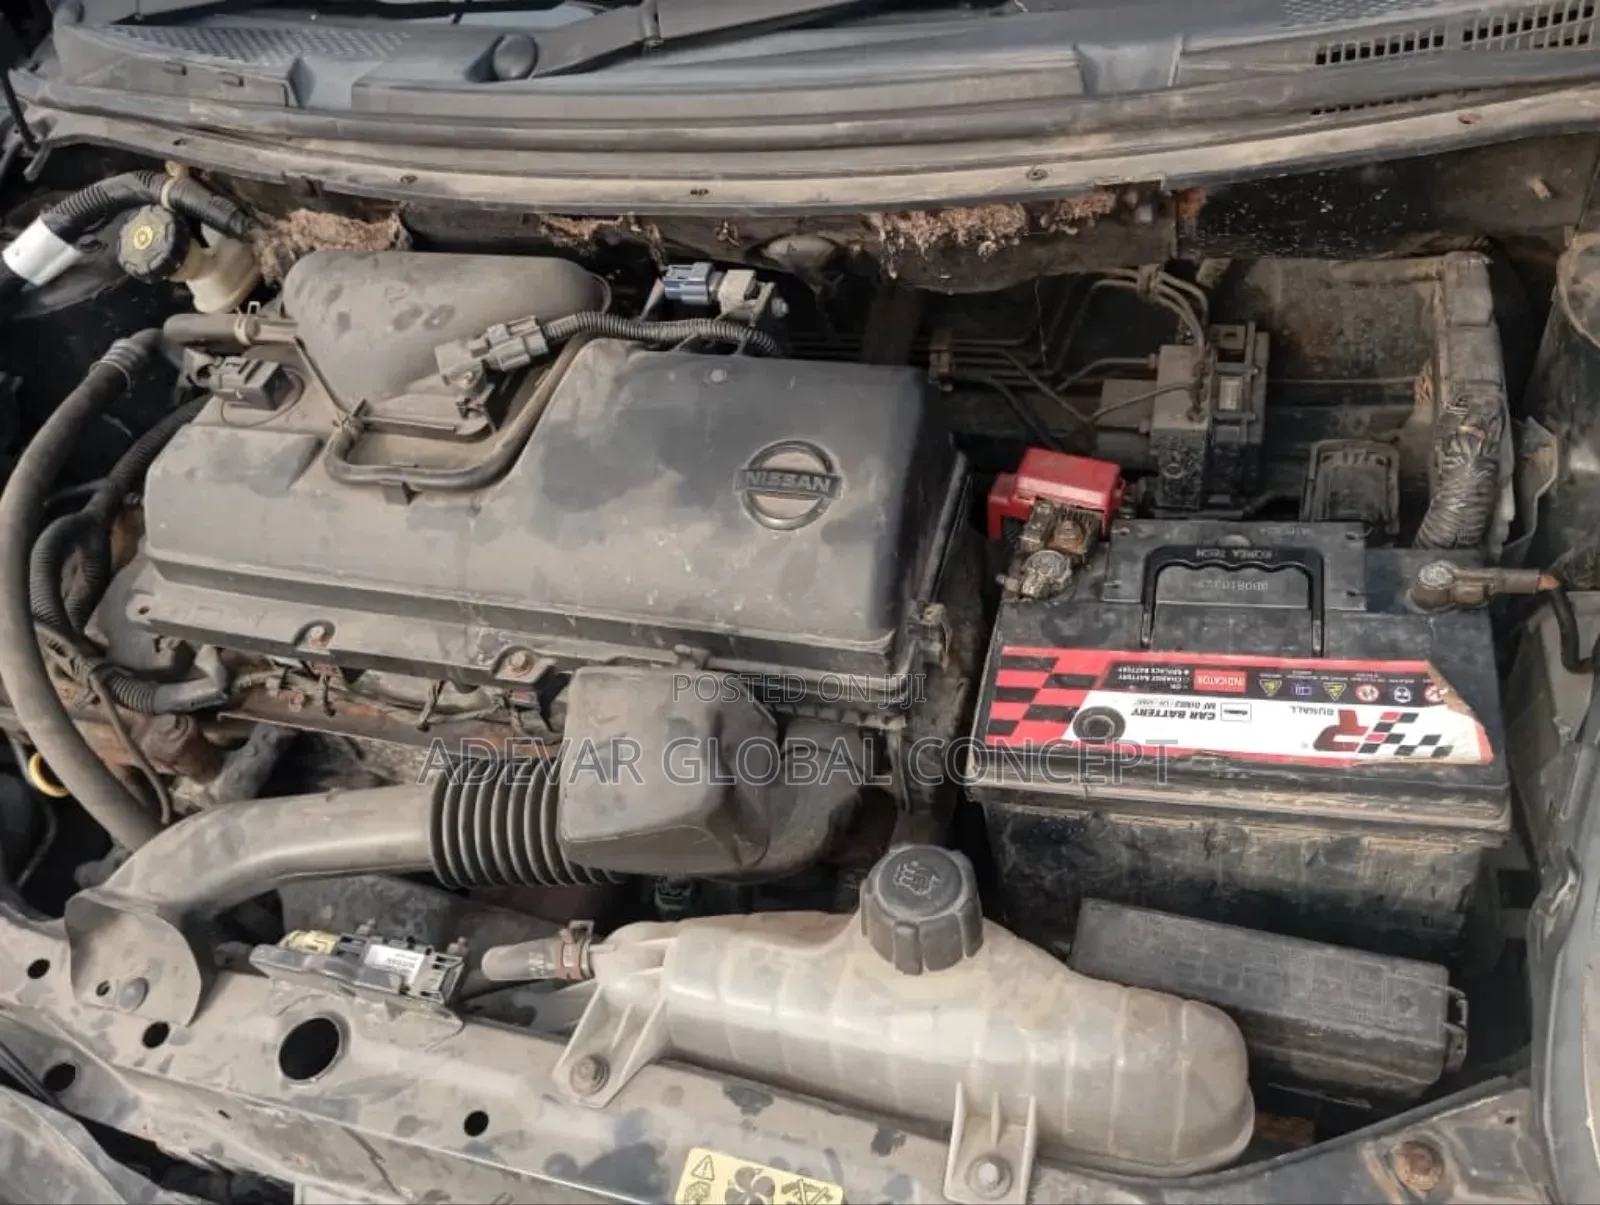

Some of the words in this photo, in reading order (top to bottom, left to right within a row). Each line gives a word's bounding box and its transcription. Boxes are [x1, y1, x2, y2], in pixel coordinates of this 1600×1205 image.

[745, 470, 829, 492] NISSAN
[1196, 547, 1226, 559] TECH
[1232, 548, 1273, 560] KOREA
[1197, 675, 1244, 687] INDICATOR
[1130, 708, 1187, 720] BATTERY
[1189, 711, 1216, 721] CAR
